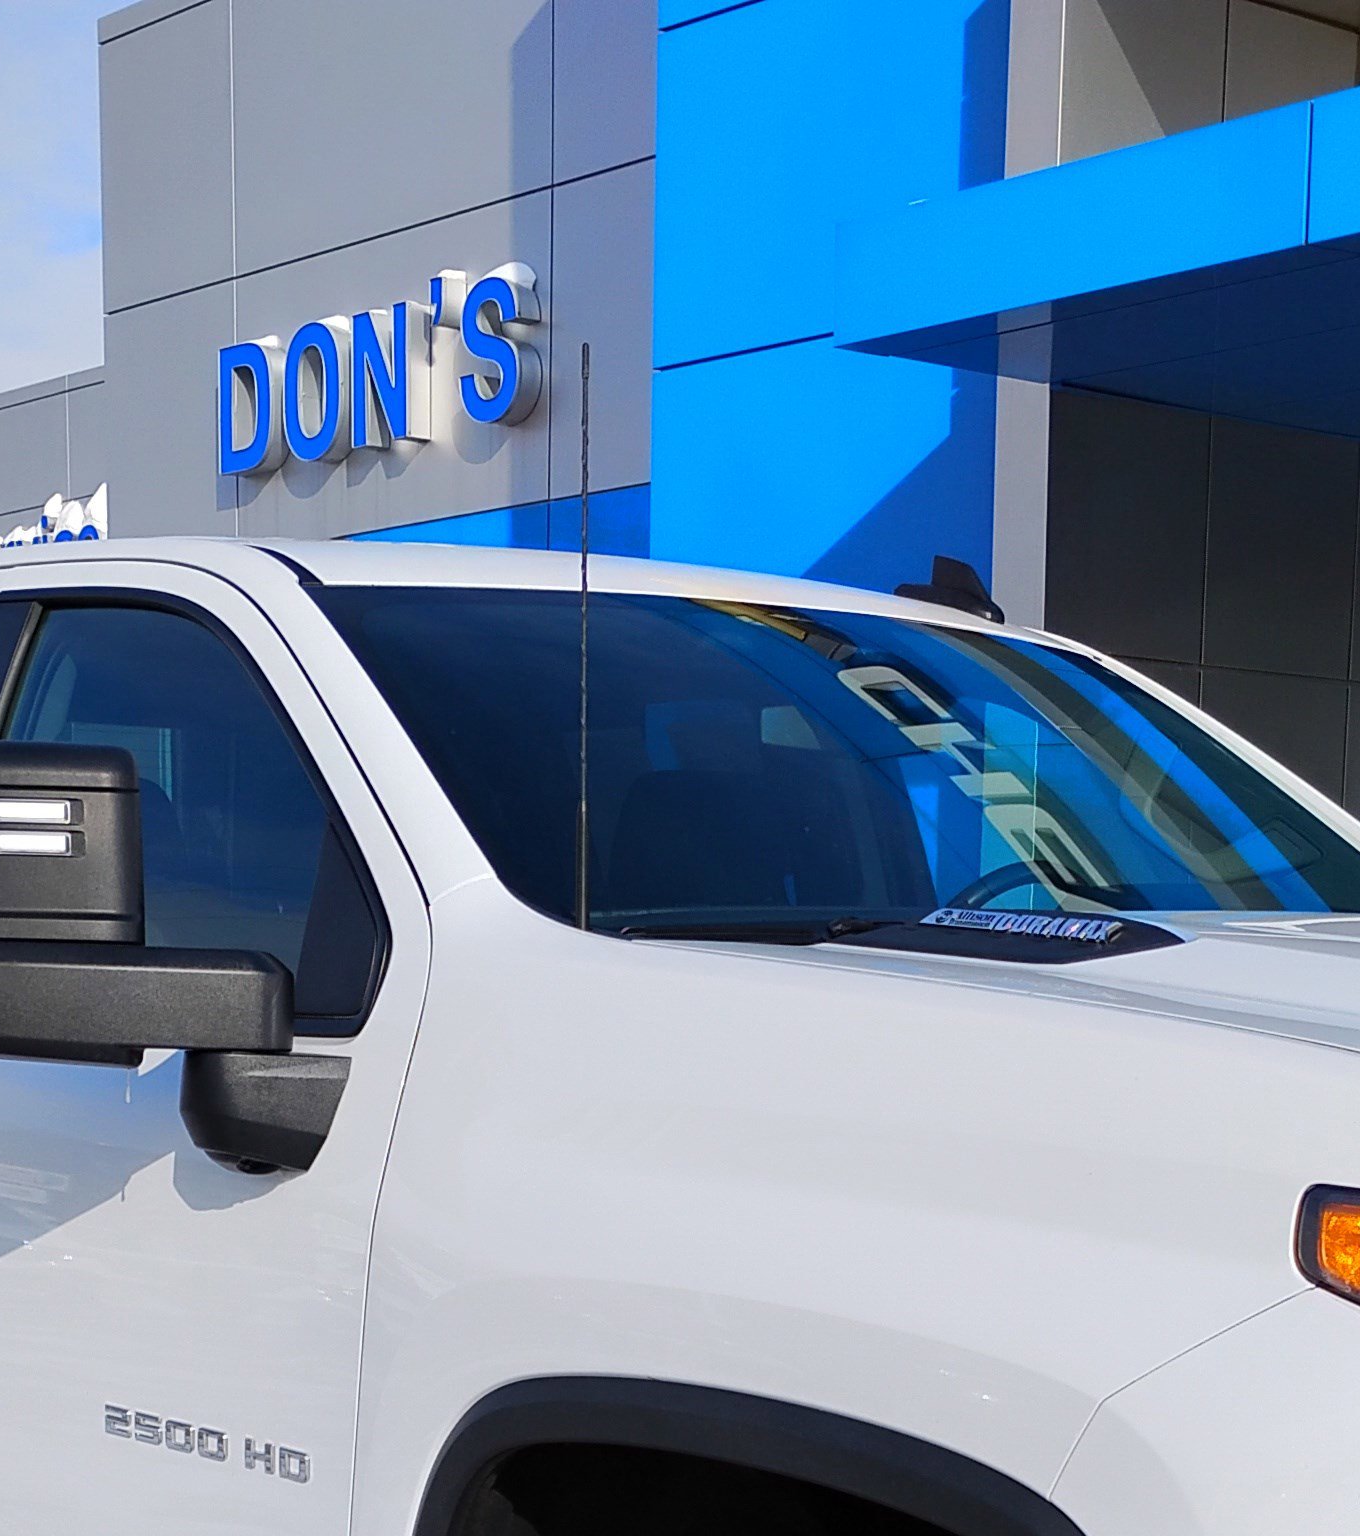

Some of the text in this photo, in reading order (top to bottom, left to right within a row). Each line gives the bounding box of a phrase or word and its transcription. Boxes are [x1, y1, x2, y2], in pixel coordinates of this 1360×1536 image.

[218, 270, 542, 476] DON'S
[104, 1400, 312, 1484] 2500 HD
